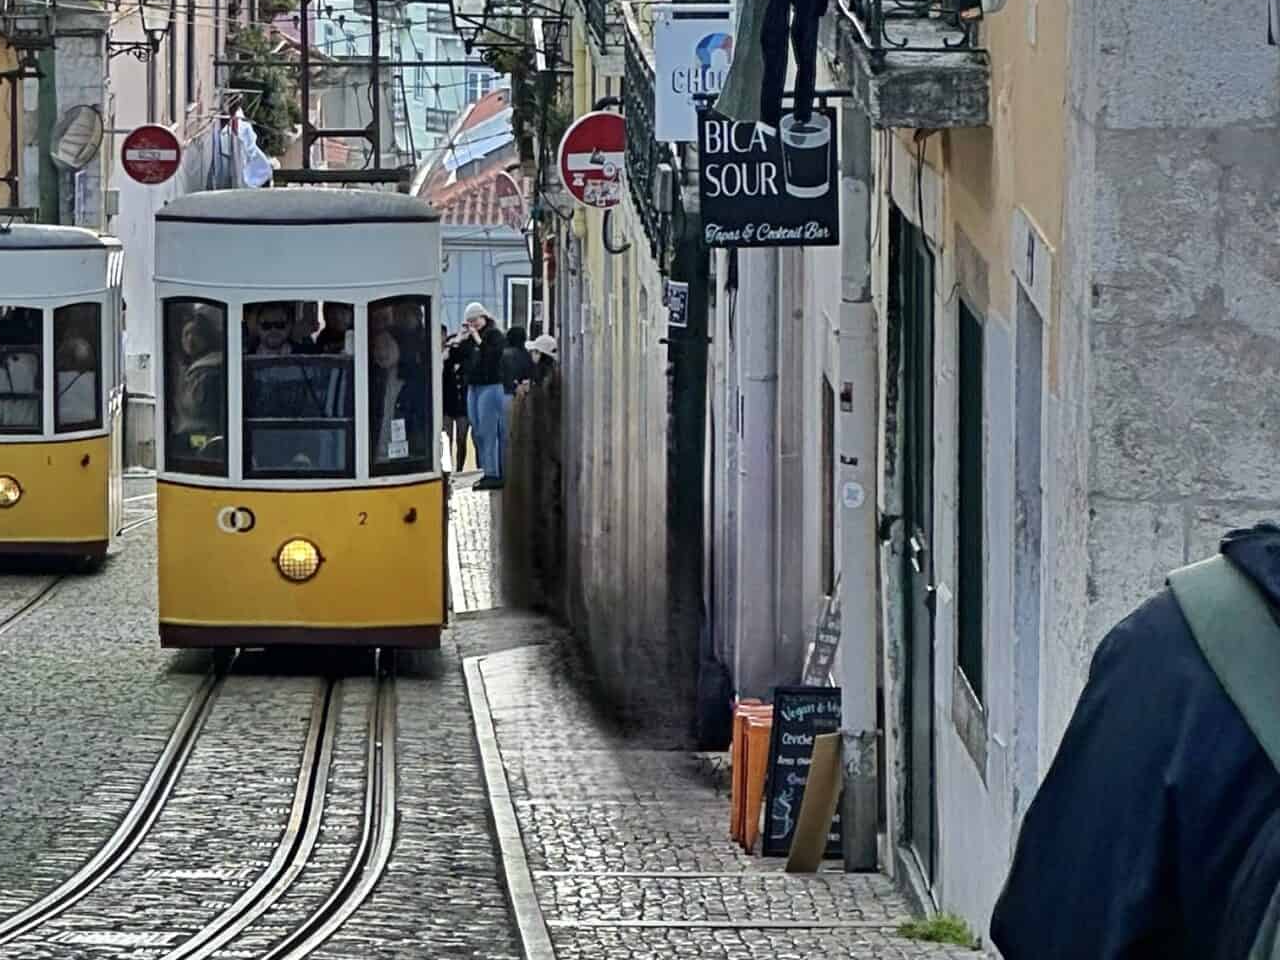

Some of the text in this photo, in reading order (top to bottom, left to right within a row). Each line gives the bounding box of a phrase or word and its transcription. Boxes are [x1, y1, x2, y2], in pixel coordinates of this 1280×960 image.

[705, 120, 767, 153] BICA
[705, 161, 778, 197] SOUR
[803, 221, 830, 239] Bar
[358, 511, 368, 526] 2
